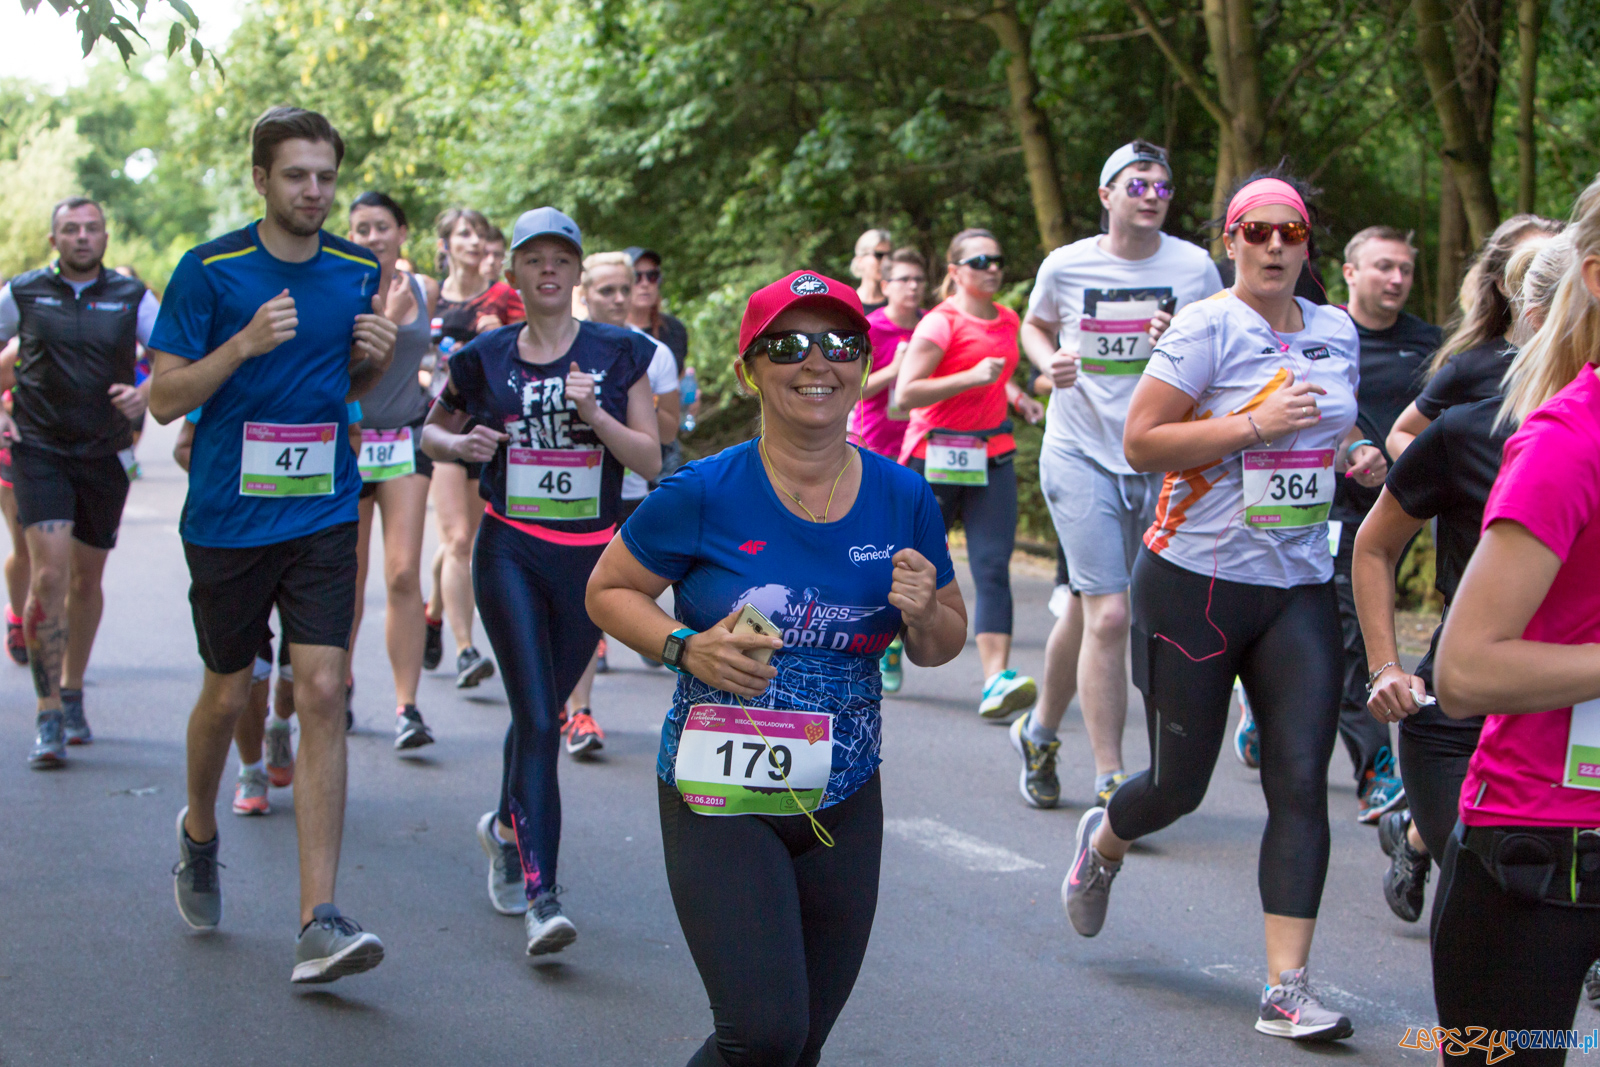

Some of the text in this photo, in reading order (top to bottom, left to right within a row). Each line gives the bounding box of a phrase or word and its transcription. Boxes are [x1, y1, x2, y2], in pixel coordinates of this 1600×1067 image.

[1097, 336, 1139, 356] 347
[275, 447, 308, 471] 47
[365, 444, 395, 462] 187
[947, 450, 968, 467] 36
[538, 470, 572, 494] 46
[1270, 473, 1318, 500] 364
[739, 540, 767, 555] 4F
[853, 546, 891, 562] Benecol
[788, 603, 850, 620] WINGS
[782, 615, 831, 631] FOR LIFE
[780, 628, 849, 650] ORLD
[716, 740, 792, 781] 179
[685, 794, 724, 806] 22.06.2018
